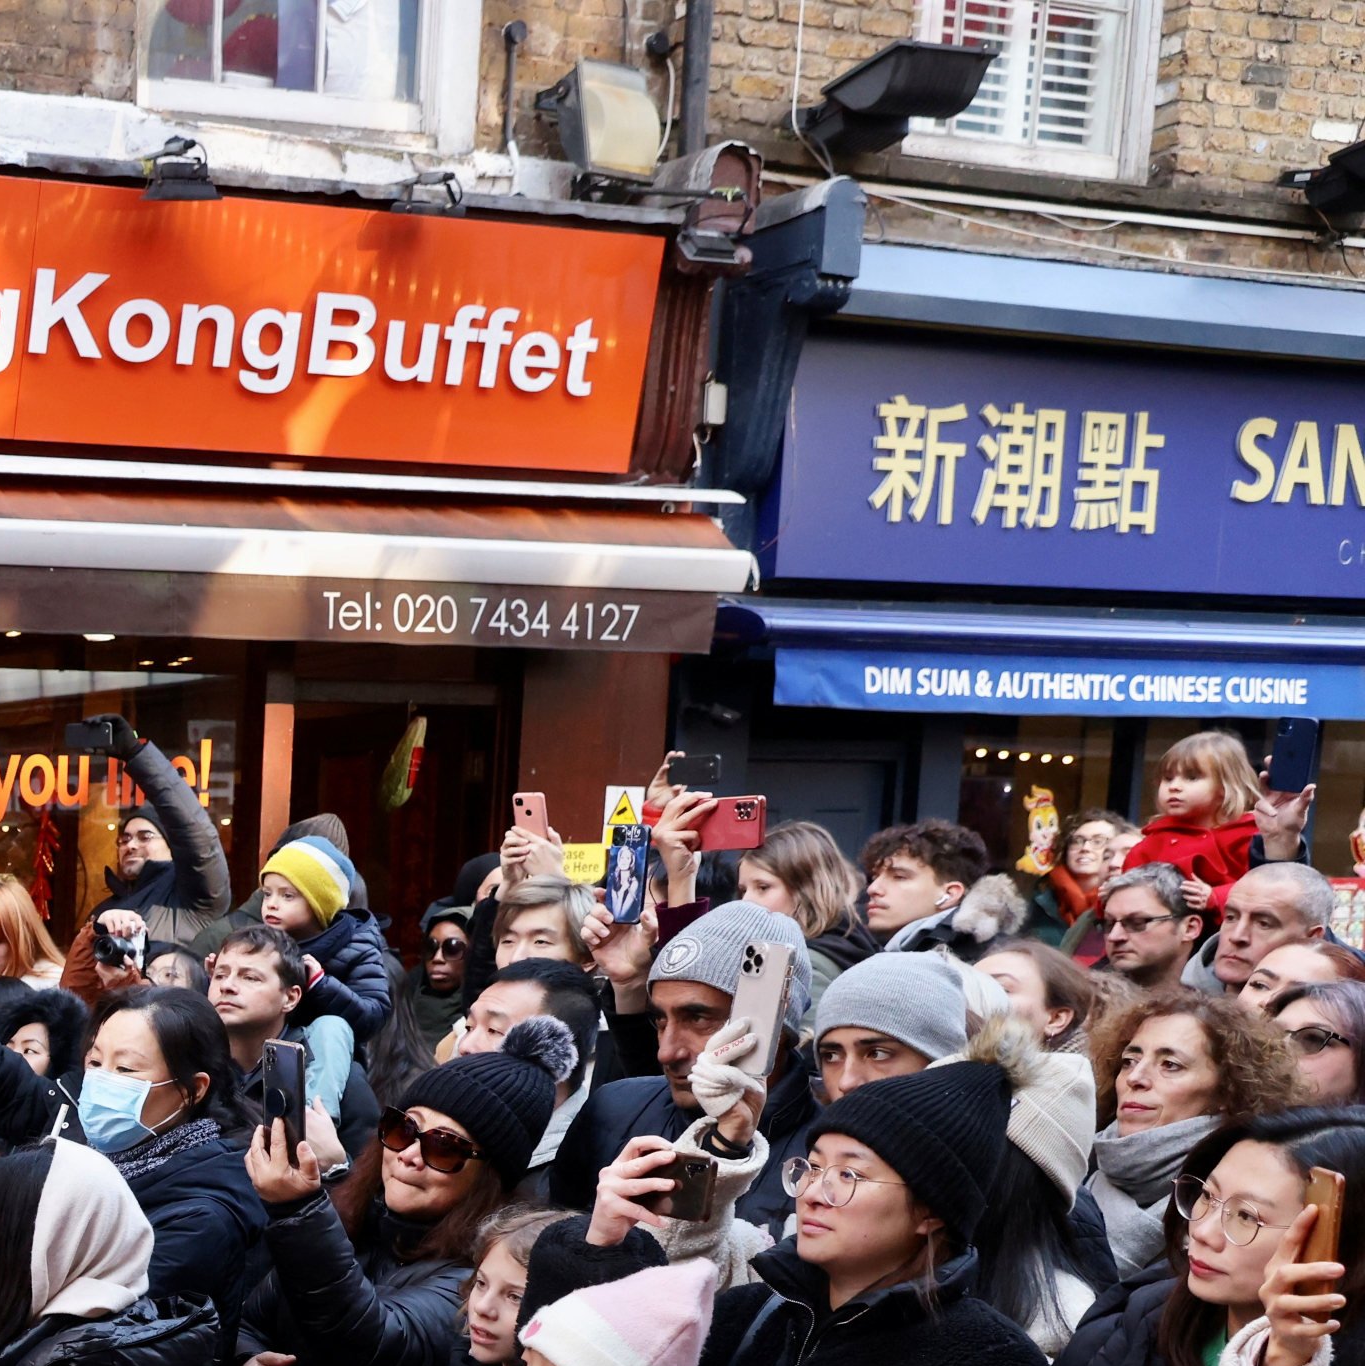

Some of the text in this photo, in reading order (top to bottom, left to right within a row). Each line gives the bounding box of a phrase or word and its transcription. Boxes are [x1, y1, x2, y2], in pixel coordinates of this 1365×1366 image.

[868, 394, 1165, 534] 新潮點
[323, 591, 641, 642] Tel: 020 7434 4127
[864, 666, 1307, 705] DIM SUM & AUTHENTIC CHINESE CUISINE
[573, 861, 599, 873] Here
